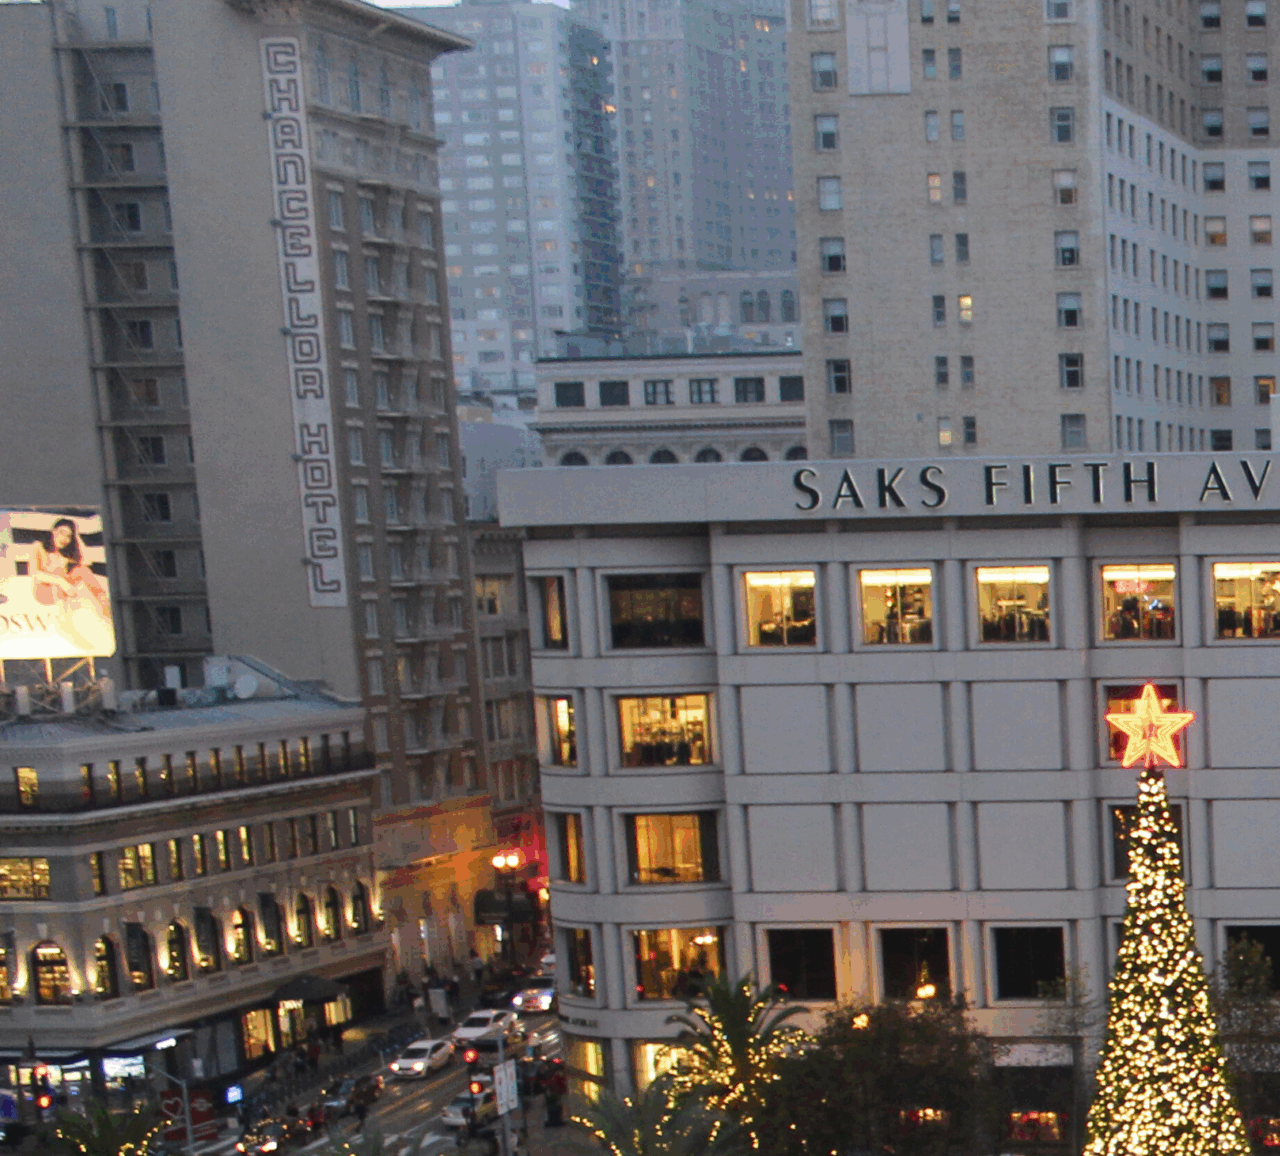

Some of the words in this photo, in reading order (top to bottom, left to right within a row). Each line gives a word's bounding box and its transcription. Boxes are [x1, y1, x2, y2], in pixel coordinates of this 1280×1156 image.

[266, 42, 323, 398] CHANCELLOR
[302, 423, 340, 593] HOTEL
[793, 464, 948, 510] SAKS
[984, 461, 1160, 506] FIFTH
